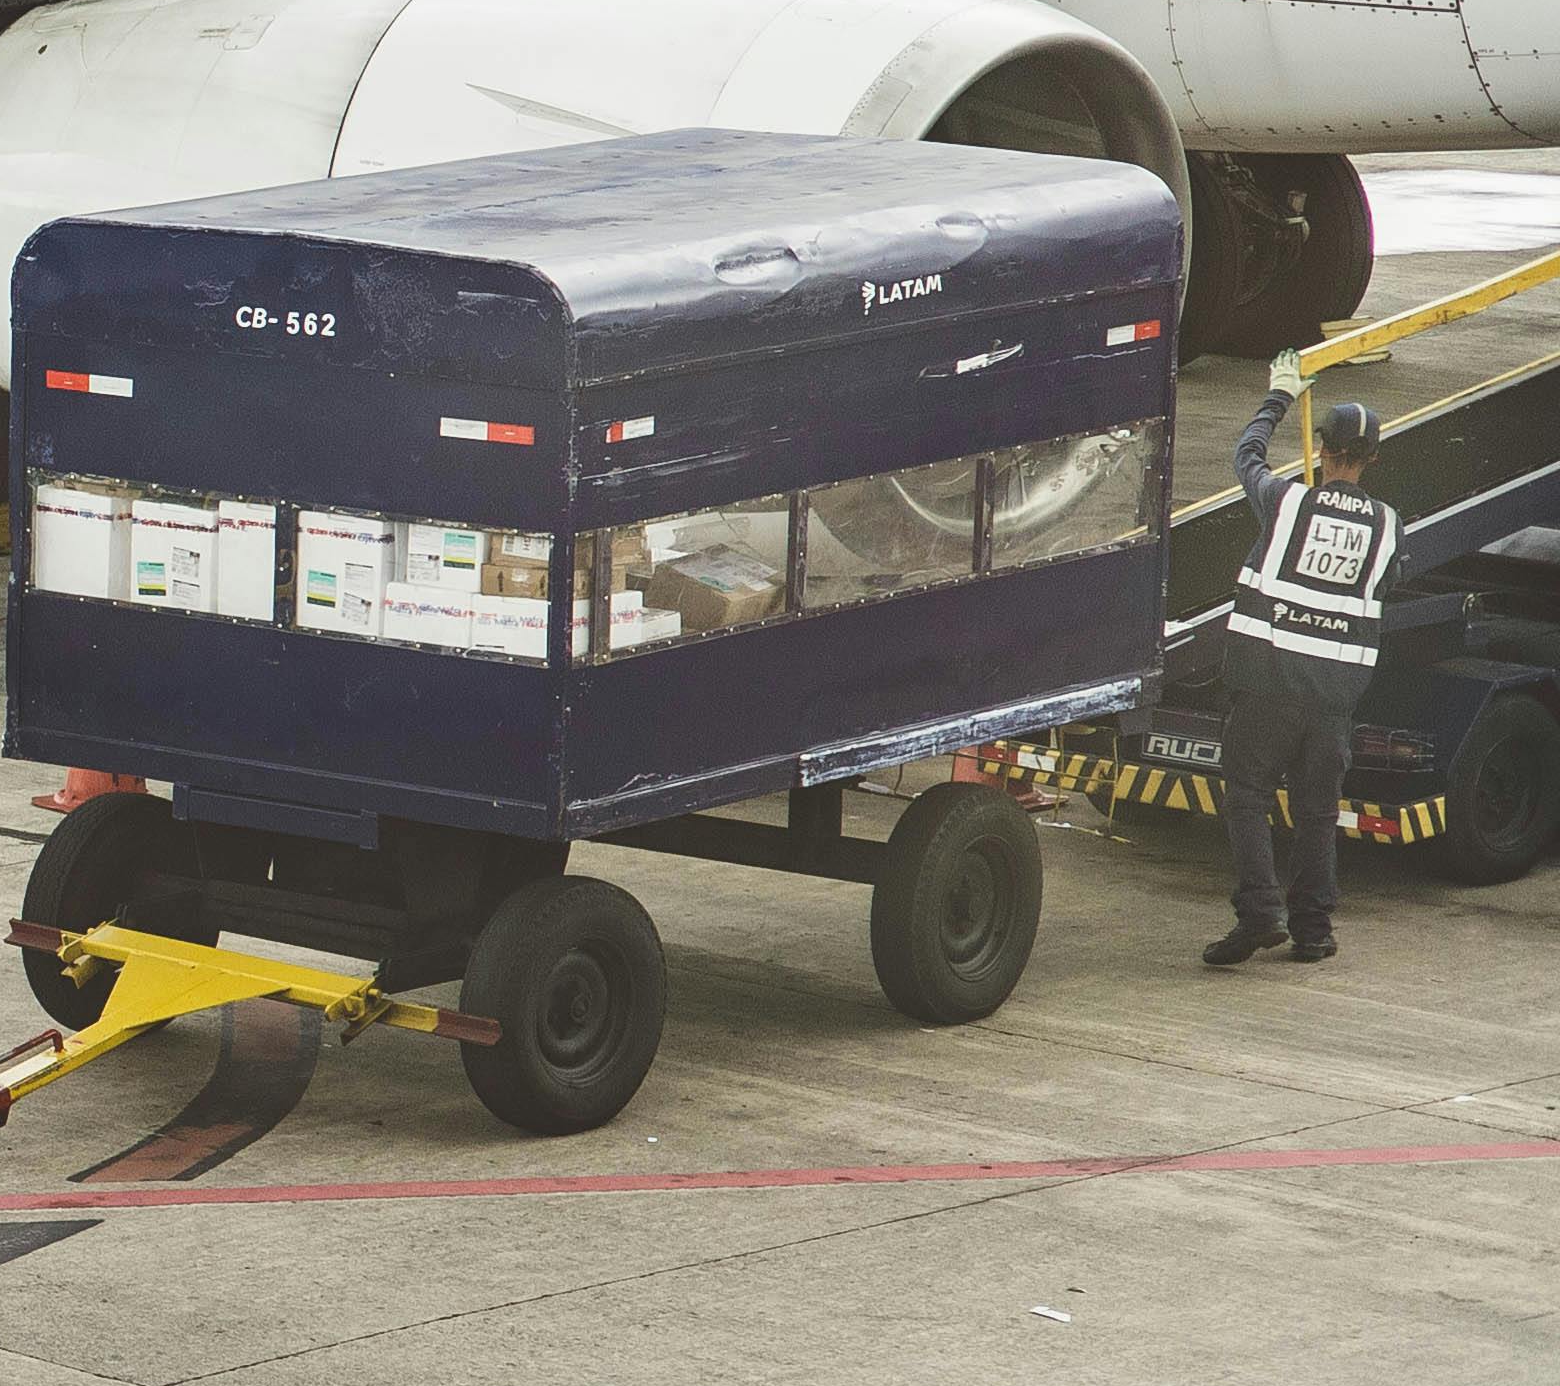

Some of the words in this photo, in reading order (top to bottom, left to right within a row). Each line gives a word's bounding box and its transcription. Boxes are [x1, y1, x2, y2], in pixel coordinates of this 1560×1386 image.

[879, 274, 943, 305] LATAM
[1316, 490, 1374, 516] RAMPA
[1312, 522, 1363, 554] LTM
[1305, 548, 1359, 580] 1073
[1288, 609, 1349, 633] LATAM
